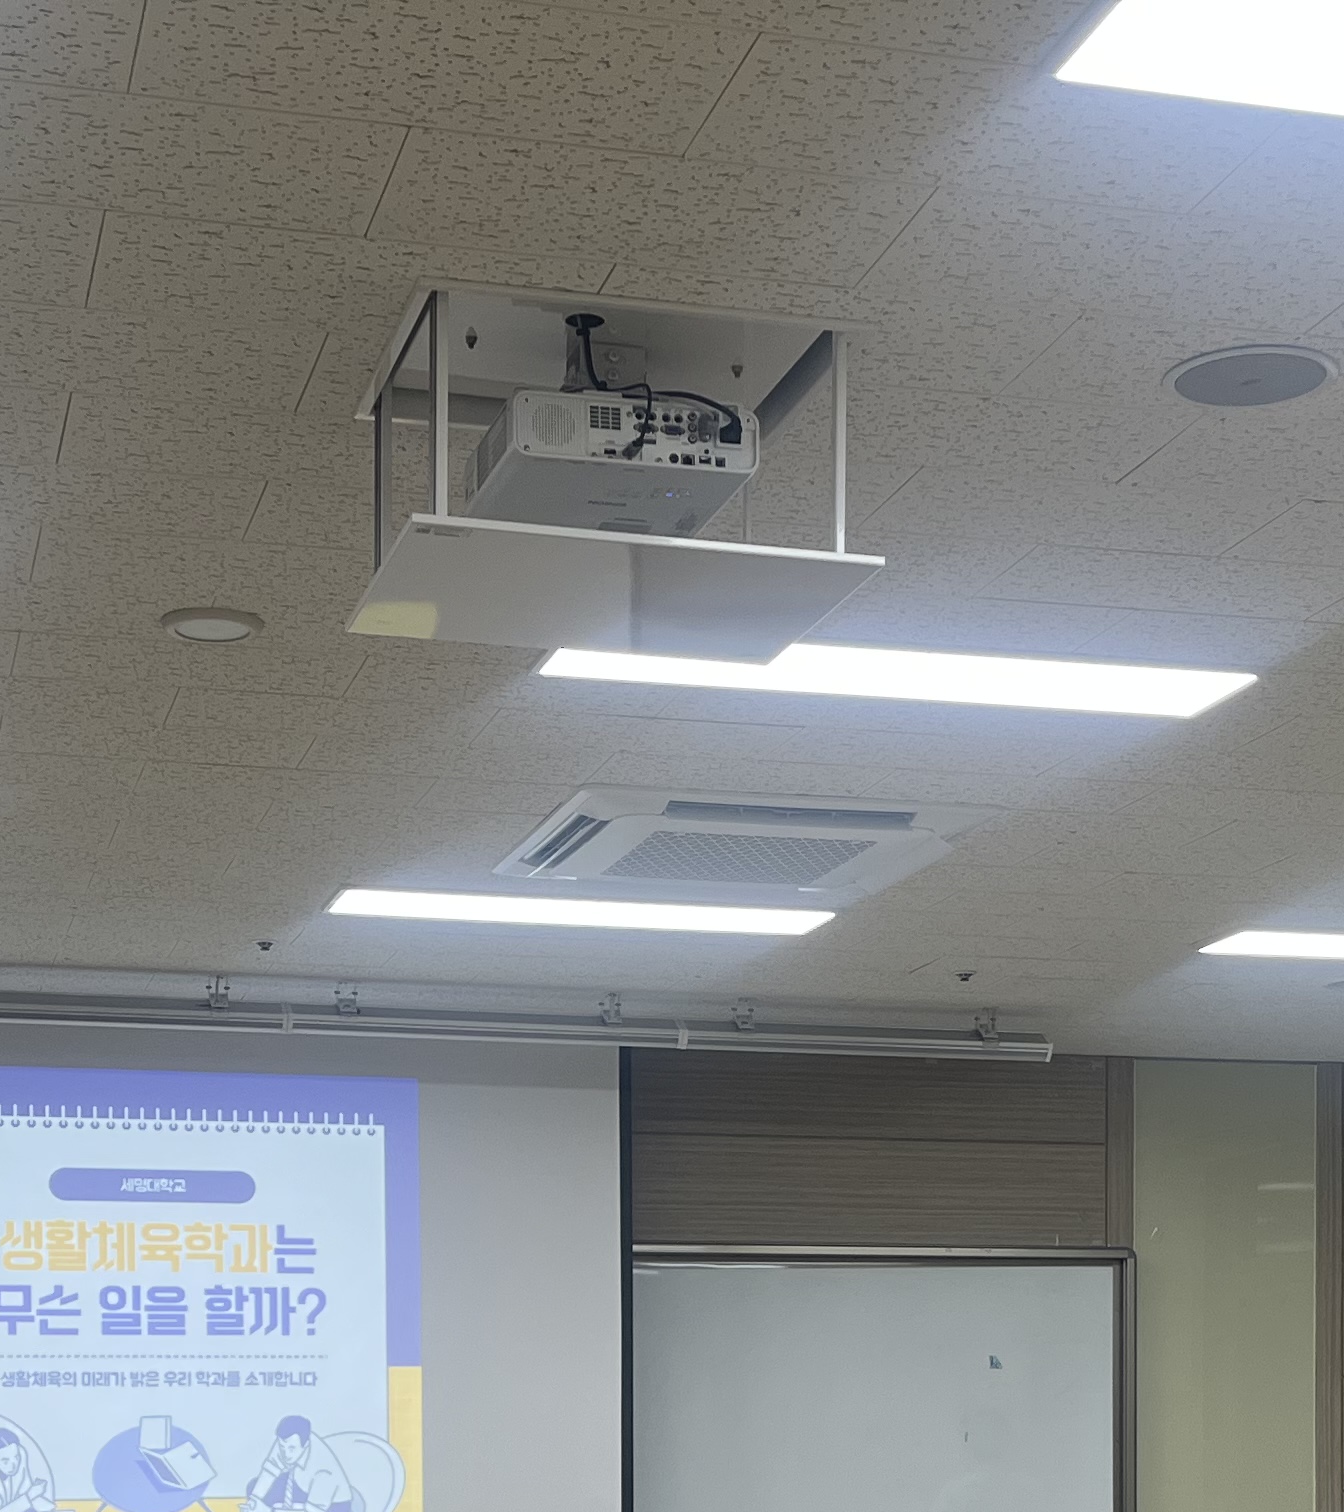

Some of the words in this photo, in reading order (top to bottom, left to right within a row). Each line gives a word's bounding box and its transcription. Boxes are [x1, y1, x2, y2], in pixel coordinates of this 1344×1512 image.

[0, 1219, 317, 1274] 생활체육학과는
[99, 1285, 189, 1336] 일을
[204, 1284, 327, 1336] 할까?
[0, 1370, 77, 1388] 생활체육의
[81, 1371, 127, 1388] 미래가
[129, 1371, 159, 1388] 밝은
[163, 1371, 192, 1387] 우리
[195, 1371, 240, 1388] 학과를
[244, 1371, 318, 1387] 소개합니다
